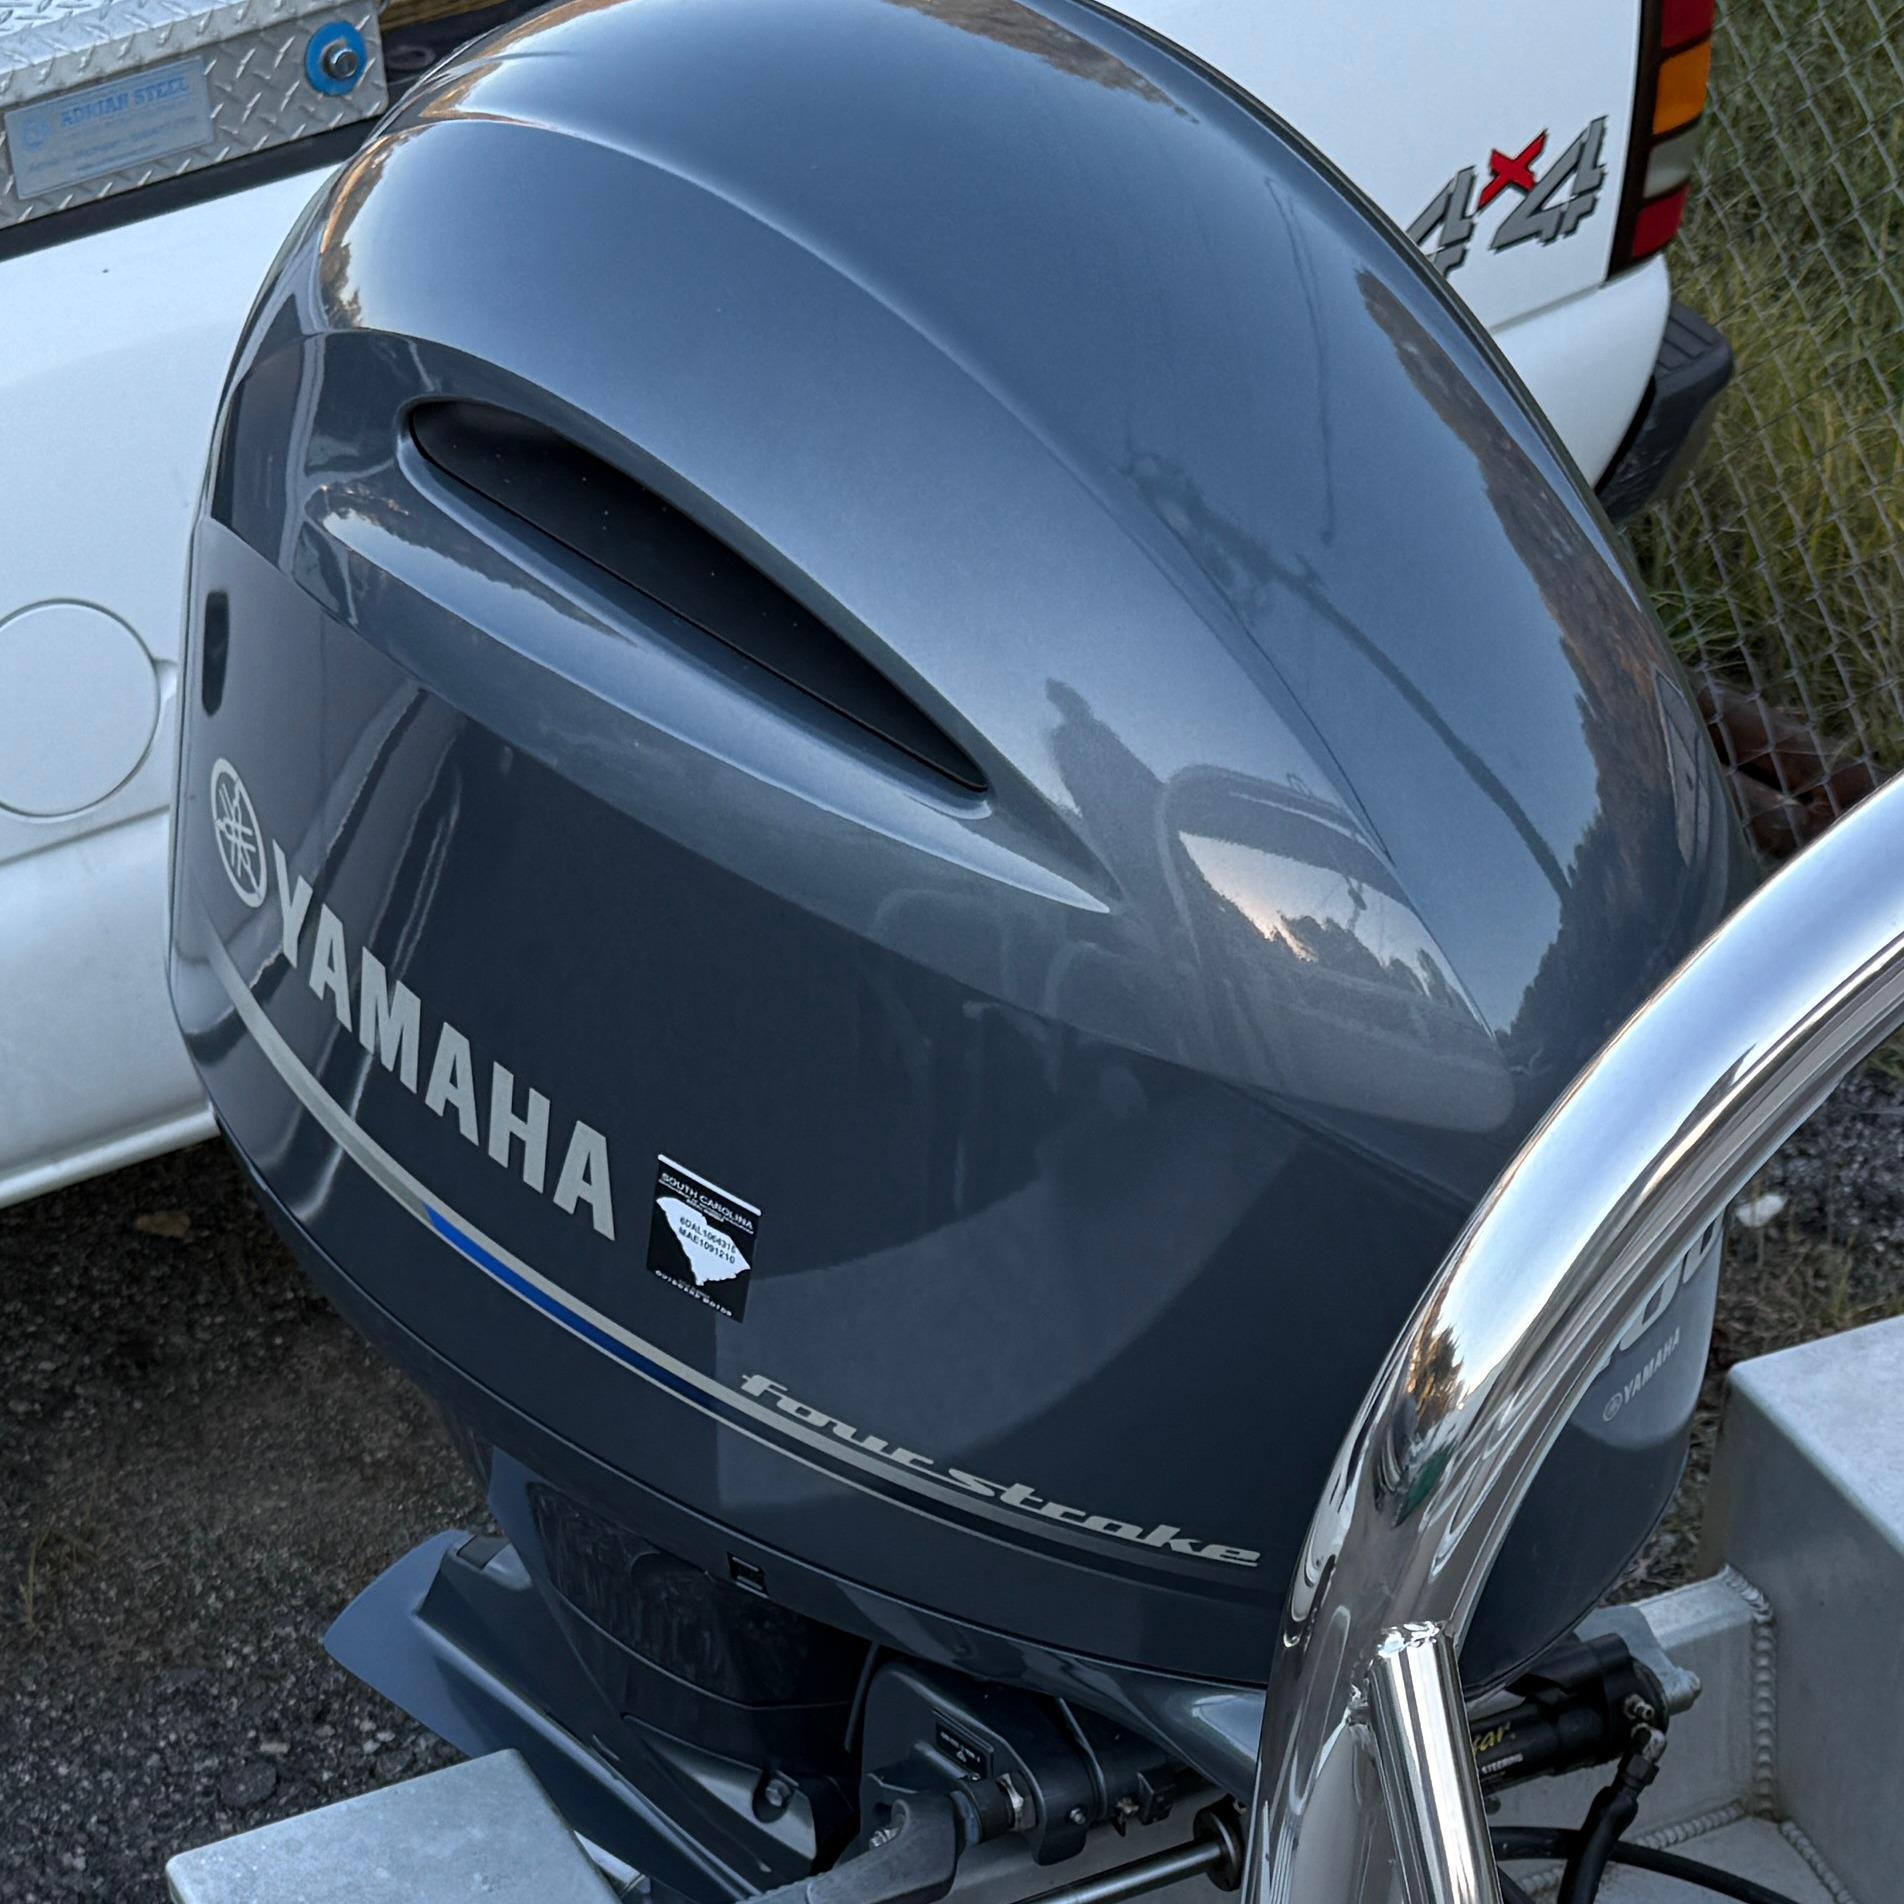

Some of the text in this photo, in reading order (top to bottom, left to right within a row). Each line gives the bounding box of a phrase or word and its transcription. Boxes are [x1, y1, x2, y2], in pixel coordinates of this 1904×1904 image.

[272, 838, 616, 1242] YAMAHA
[659, 1172, 698, 1200] SOUTH
[699, 1194, 755, 1231] CAROLINA
[1621, 1326, 1681, 1404] YAMAHA
